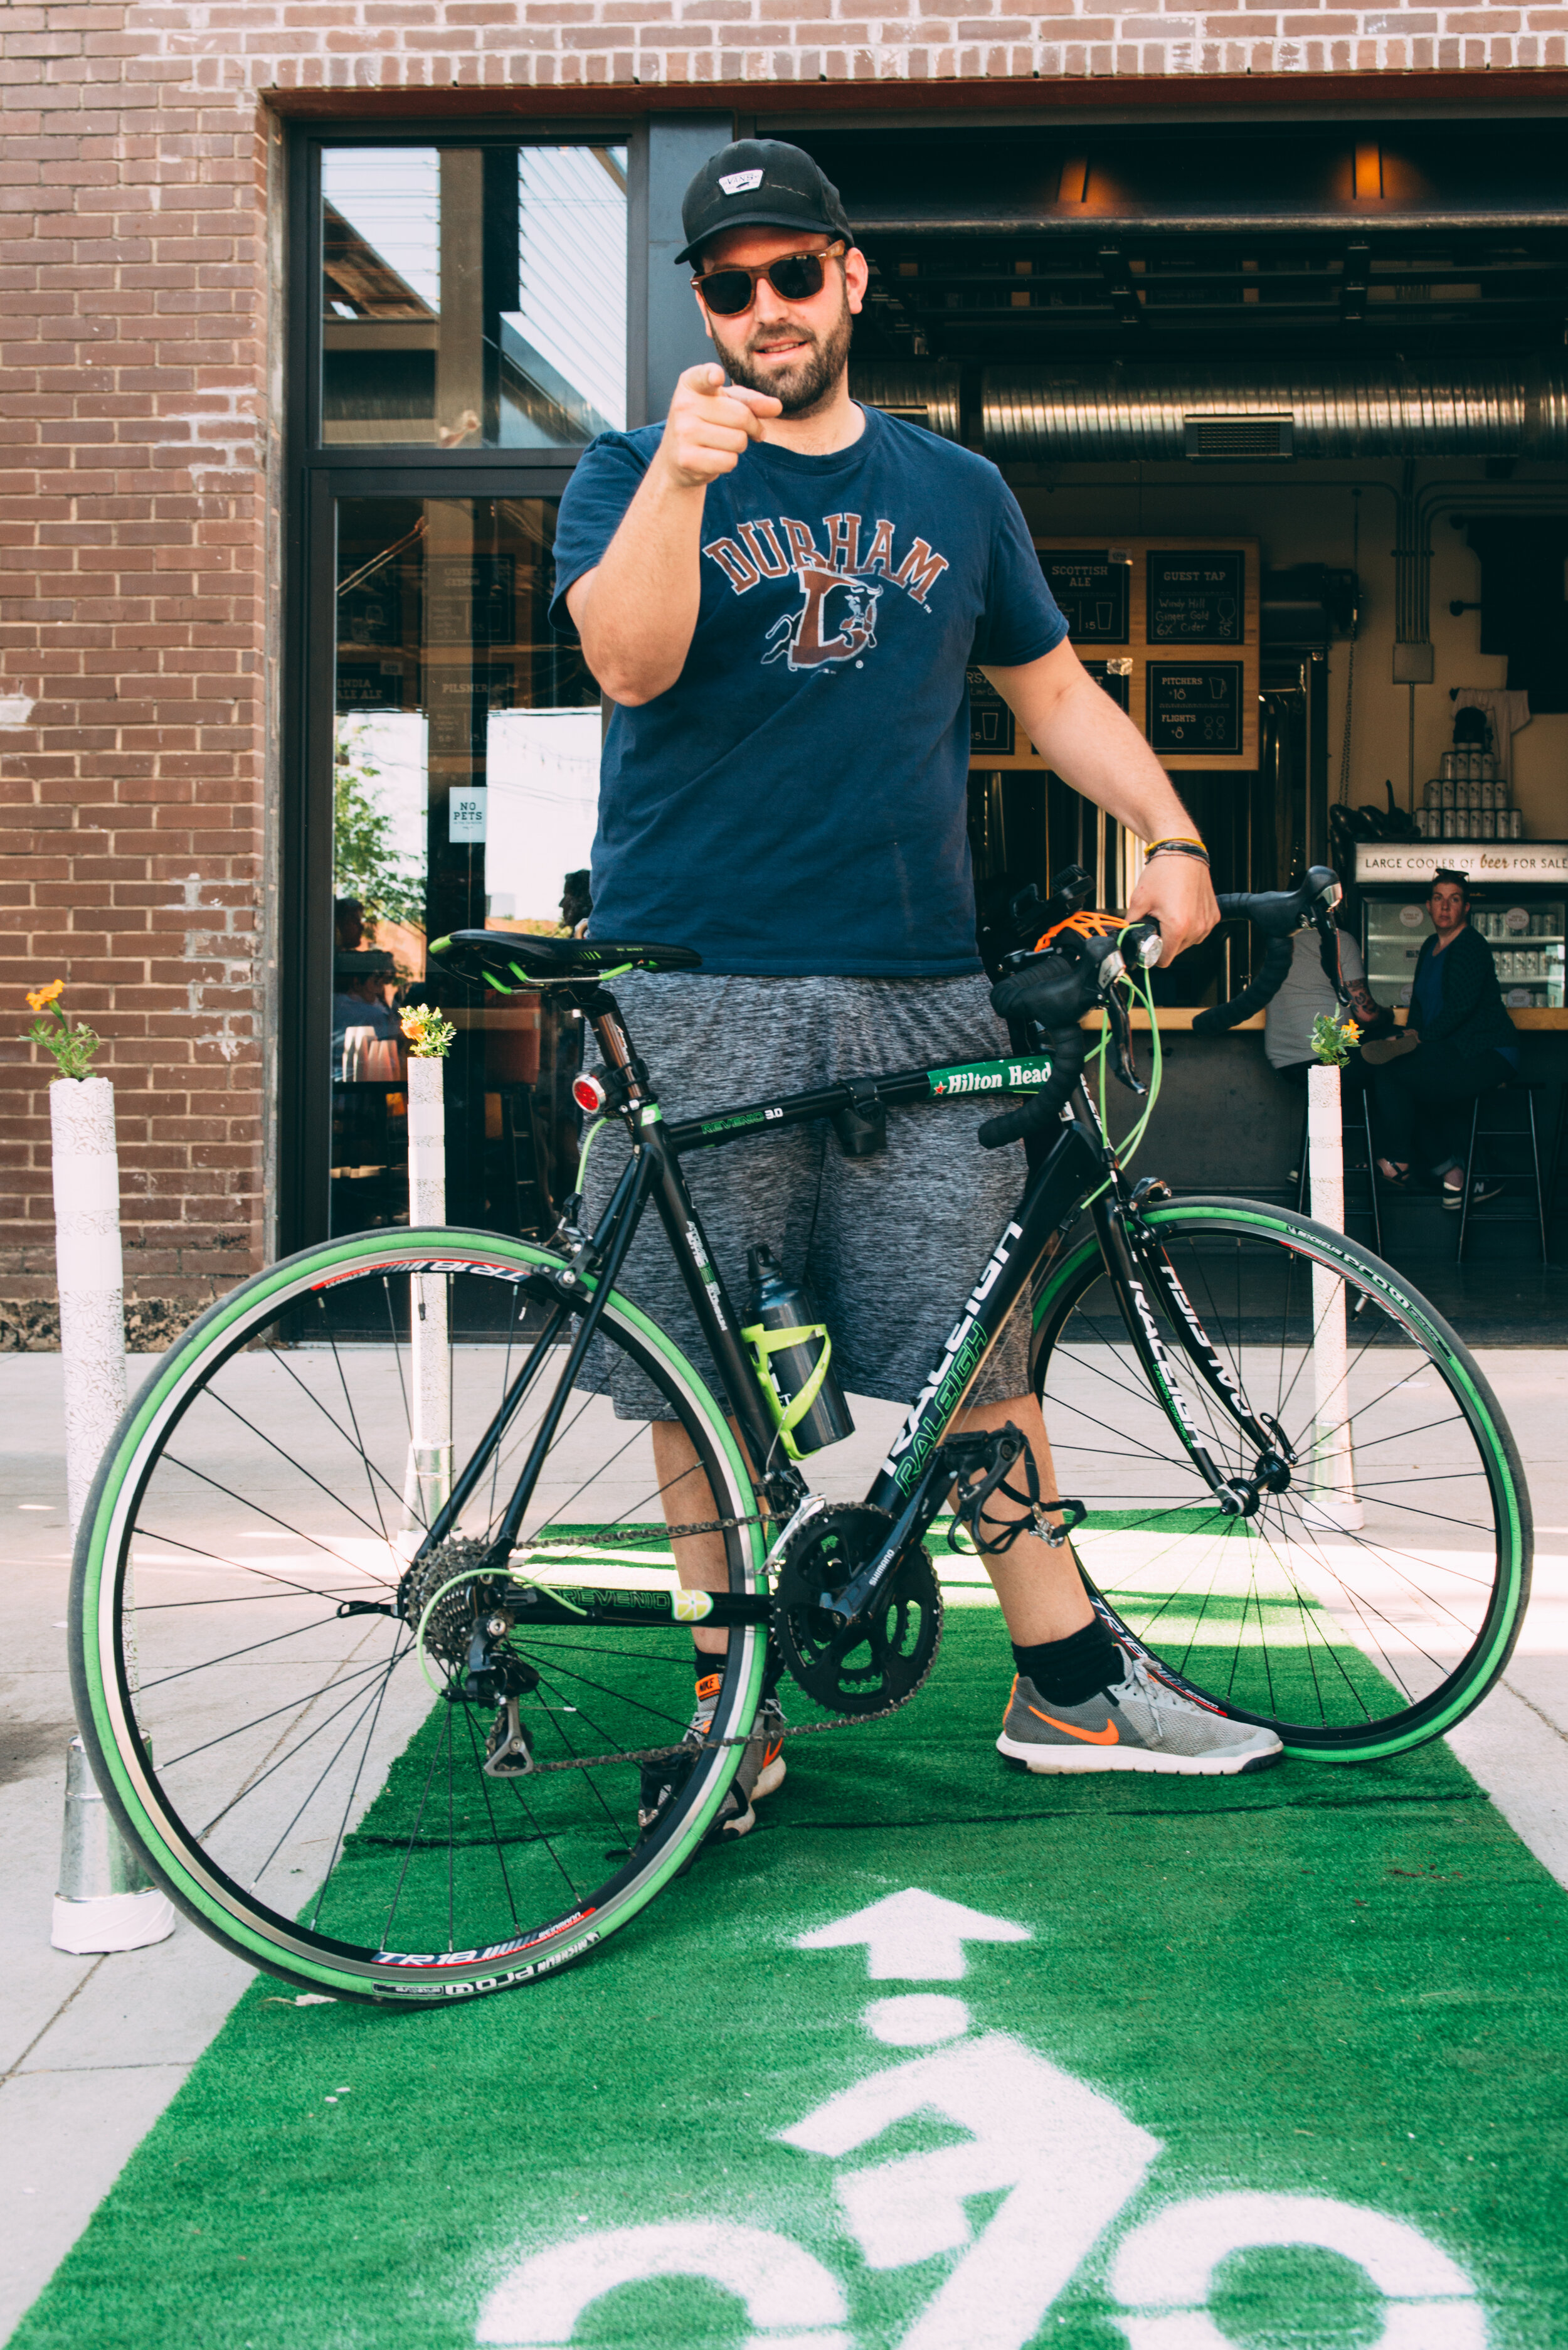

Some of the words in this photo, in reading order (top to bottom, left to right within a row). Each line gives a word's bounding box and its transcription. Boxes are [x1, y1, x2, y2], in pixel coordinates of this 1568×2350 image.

[727, 174, 753, 184] VANS
[702, 512, 949, 604] DURHAM
[1051, 566, 1108, 575] SCOTTISH
[1163, 572, 1200, 581] GUEST
[1204, 572, 1226, 581] TAP
[1069, 577, 1091, 587] ALE
[1158, 598, 1185, 612] Windy
[1188, 597, 1205, 609] Hill
[1155, 610, 1187, 625] Ginger
[1190, 610, 1209, 620] Gold
[1180, 622, 1207, 632] Cider
[442, 683, 488, 693] PILSNER
[1162, 677, 1203, 685] PITCHERS
[1161, 714, 1196, 723] FLIGHTS
[460, 802, 476, 811] NO
[453, 812, 482, 821] PETS
[1365, 858, 1402, 868] LARGE
[1407, 858, 1455, 868] COOLER
[1460, 858, 1475, 868] OF
[1480, 854, 1510, 869] beer
[1513, 858, 1536, 868] FOR
[1541, 858, 1568, 868] SALE
[946, 1072, 1003, 1095] Hilton
[1009, 1062, 1052, 1086] Head
[701, 1112, 765, 1135] REVENIO
[764, 1107, 784, 1120] 3.0
[1297, 1230, 1343, 1256] MICHELIN
[429, 1260, 527, 1282] TR18
[881, 1221, 1023, 1477] RALEIGH
[1128, 1280, 1206, 1449] RALEIGH
[894, 1321, 989, 1498] RALEIGH
[1152, 1363, 1172, 1402] CARBON
[1167, 1399, 1195, 1450] COMPOSITE
[869, 1548, 895, 1587] SHIMANO
[558, 1589, 670, 1610] REVENIO
[1090, 1597, 1148, 1659] TR18
[698, 1677, 714, 1694] NIKE
[378, 1950, 477, 1966] TR18
[537, 1938, 589, 1973] MICHELIN
